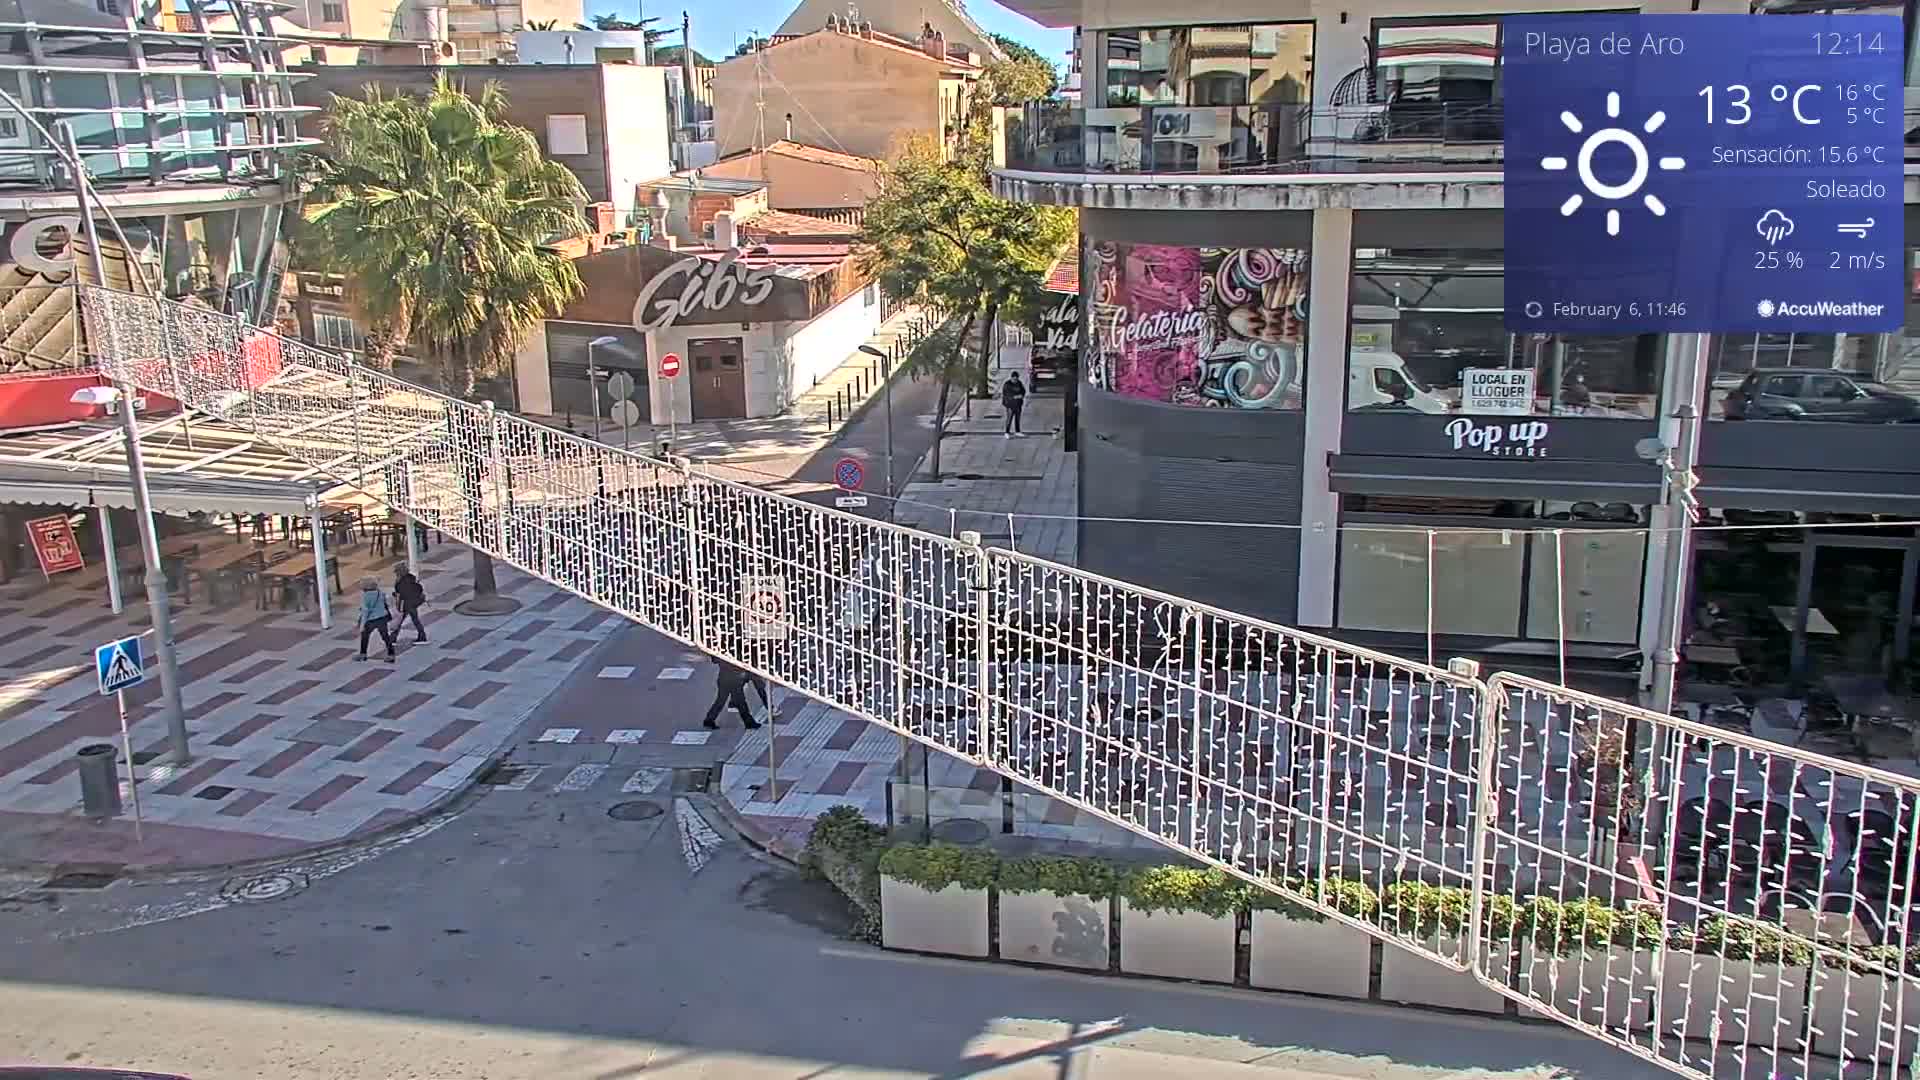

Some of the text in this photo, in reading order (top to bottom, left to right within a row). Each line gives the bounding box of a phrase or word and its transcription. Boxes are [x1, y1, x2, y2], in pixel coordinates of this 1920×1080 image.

[633, 247, 777, 333] Gib's
[1472, 374, 1526, 385] LOCAL EN
[1471, 386, 1525, 397] LLOGUER
[1445, 418, 1549, 452] Pop up
[1492, 446, 1548, 458] STORE
